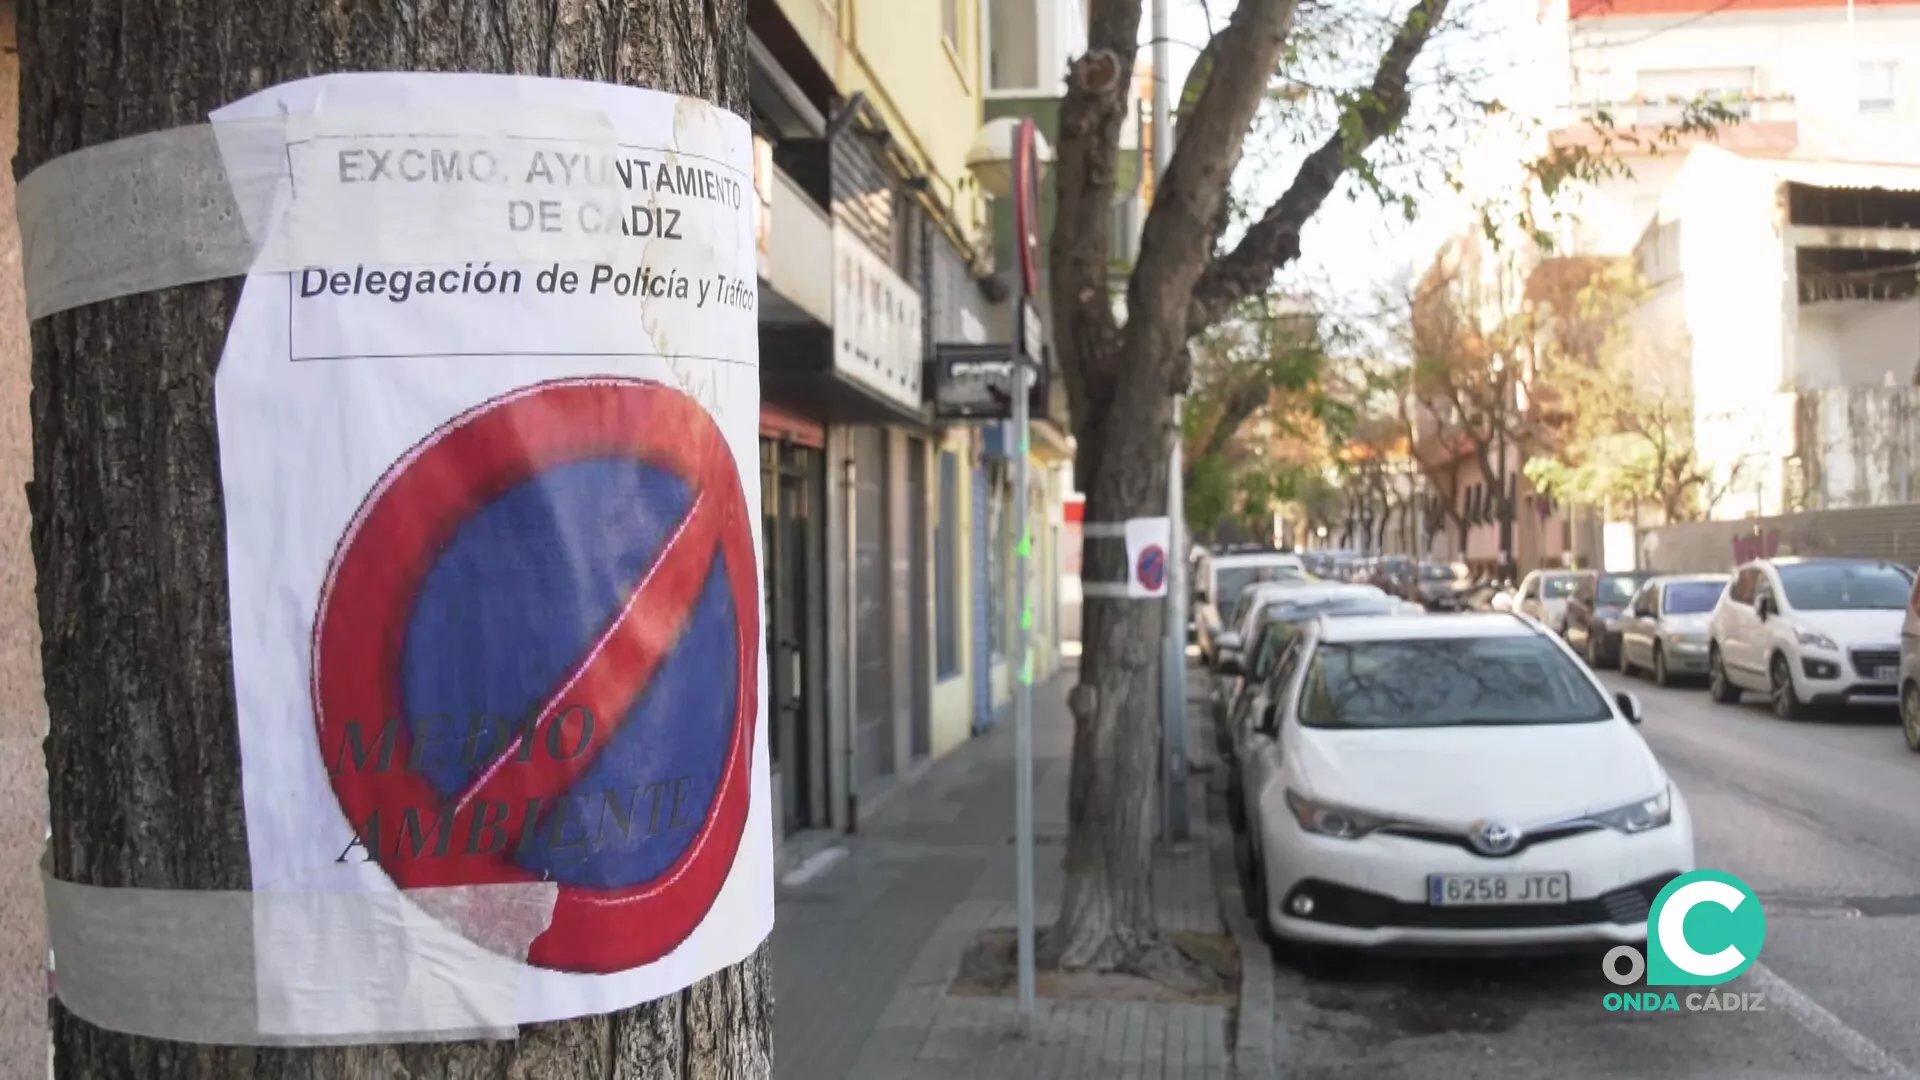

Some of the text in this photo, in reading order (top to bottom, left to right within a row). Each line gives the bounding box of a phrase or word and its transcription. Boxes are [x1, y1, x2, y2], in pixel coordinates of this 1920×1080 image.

[338, 148, 742, 210] EXCMO. AYUNTAMIENTO
[508, 199, 563, 232] DE
[301, 260, 755, 312] Delegación de Policía y Tráfico
[330, 703, 596, 776] MEDIO
[335, 776, 696, 863] AMBIENTE
[1446, 876, 1562, 900] 6258 JTC
